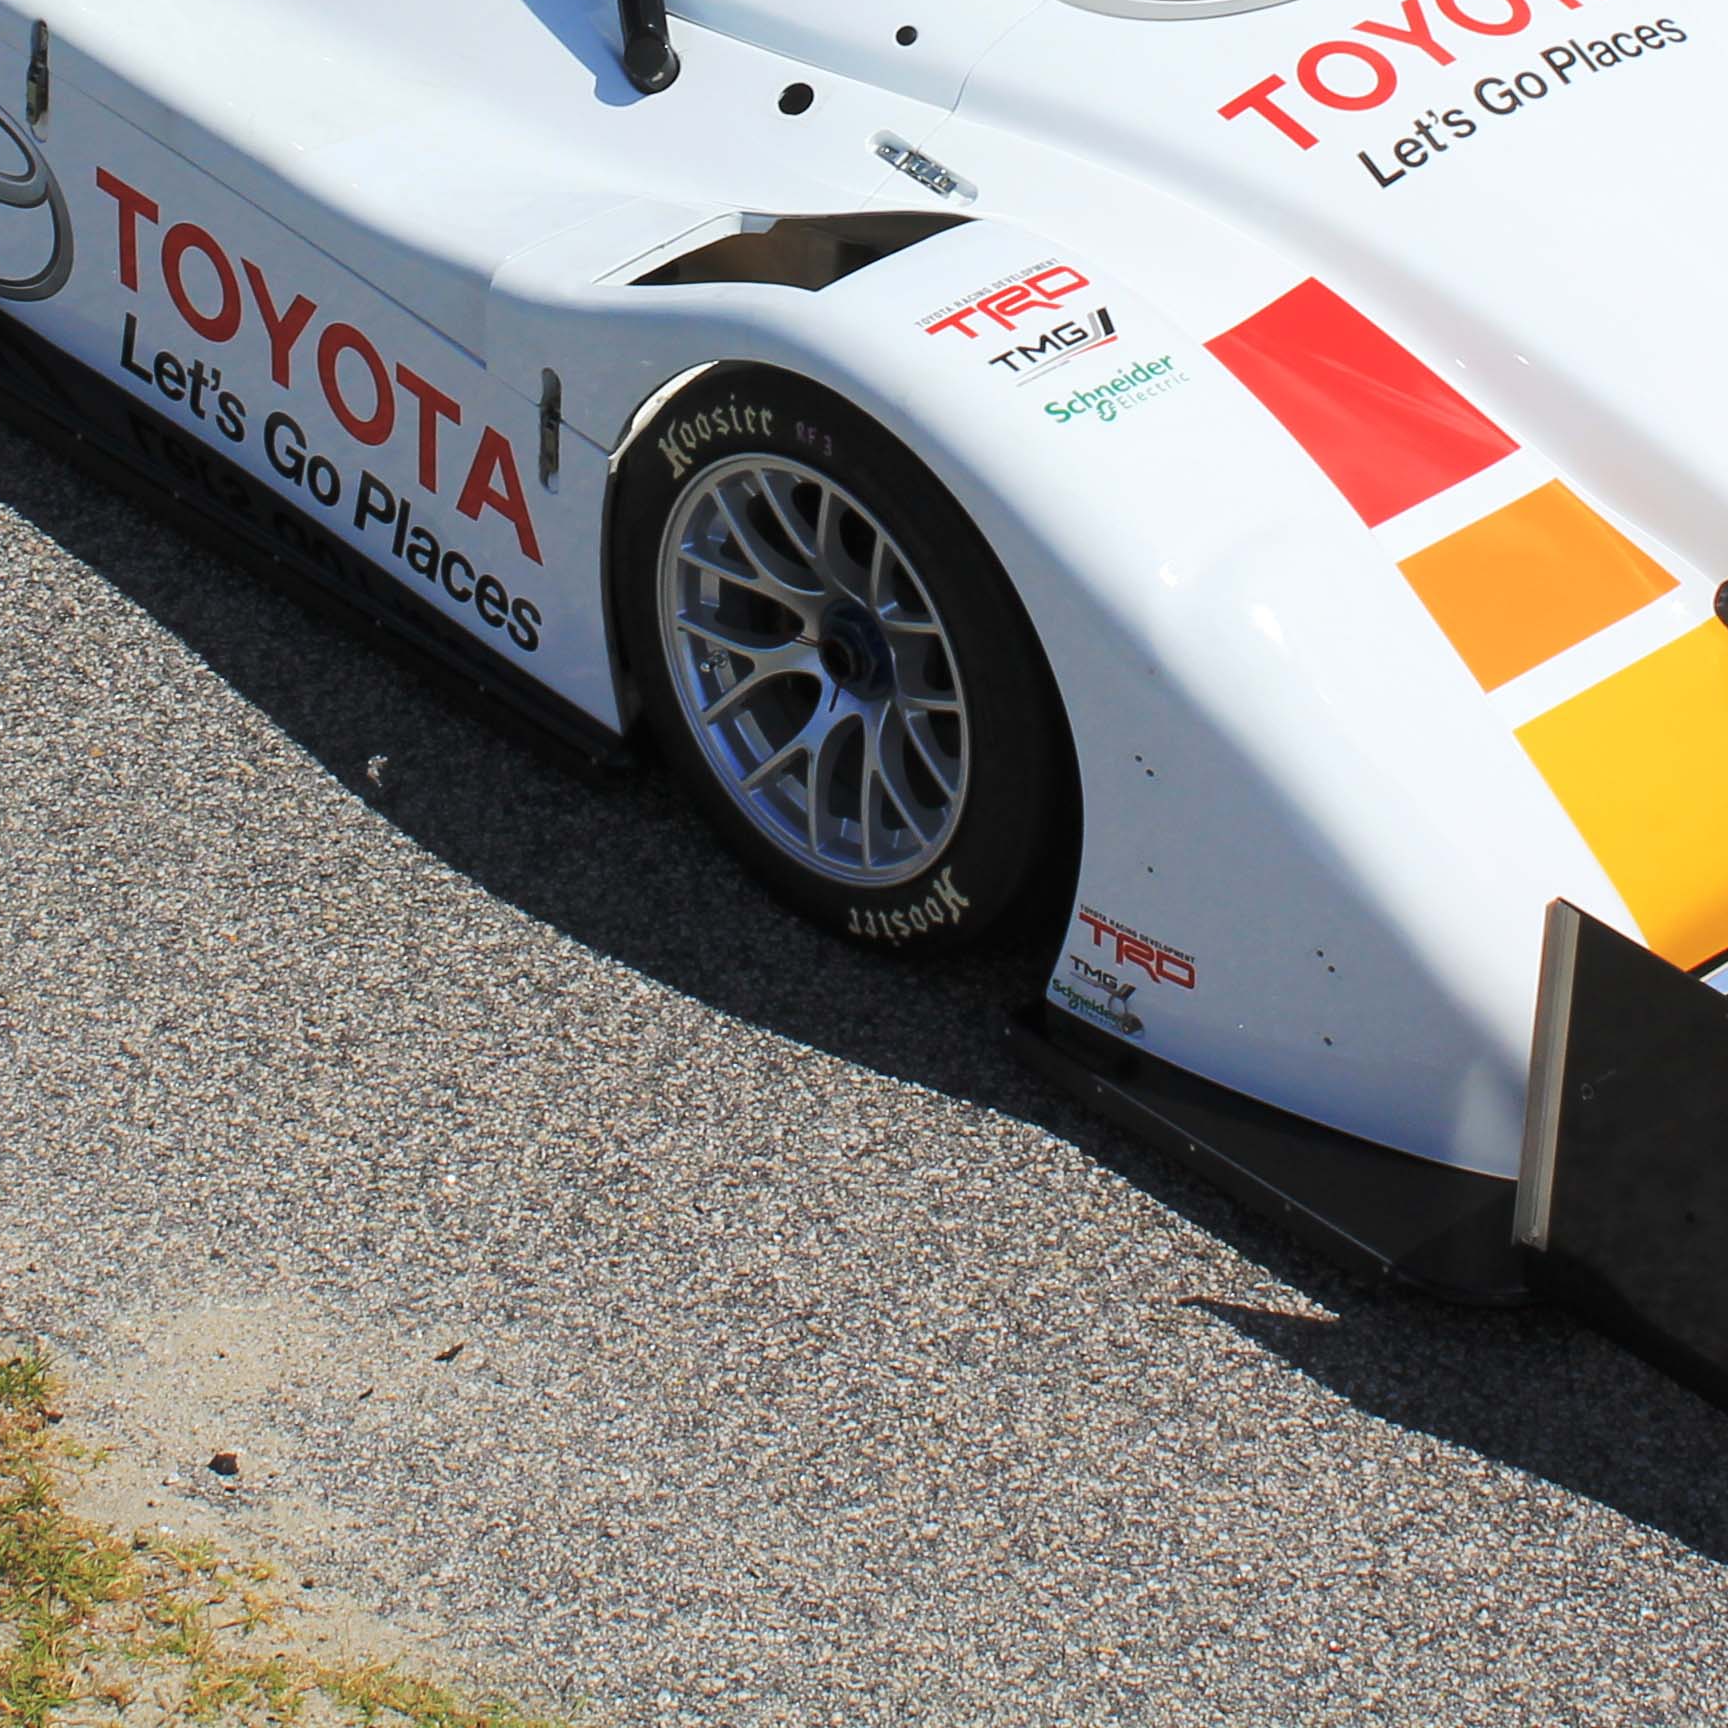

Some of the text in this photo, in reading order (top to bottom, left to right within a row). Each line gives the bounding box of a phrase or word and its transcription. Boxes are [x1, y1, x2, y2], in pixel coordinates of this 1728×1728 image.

[1357, 15, 1688, 189] Let's Go Places
[915, 258, 1061, 329] TOYOTA RACING DEVELOPMENT
[923, 265, 1090, 339] TRD
[95, 165, 544, 568] TOYOTA
[988, 321, 1089, 372] TMG
[1044, 355, 1175, 424] Schneider
[1119, 371, 1191, 413] Electric
[657, 393, 775, 479] Hoosier
[120, 311, 543, 653] Let's Go Places
[848, 865, 970, 947] Hoosier
[1079, 903, 1196, 964] TOYOTA RACING DEVELOPMENT
[1070, 954, 1119, 990] TMG
[1078, 911, 1196, 989] TRD
